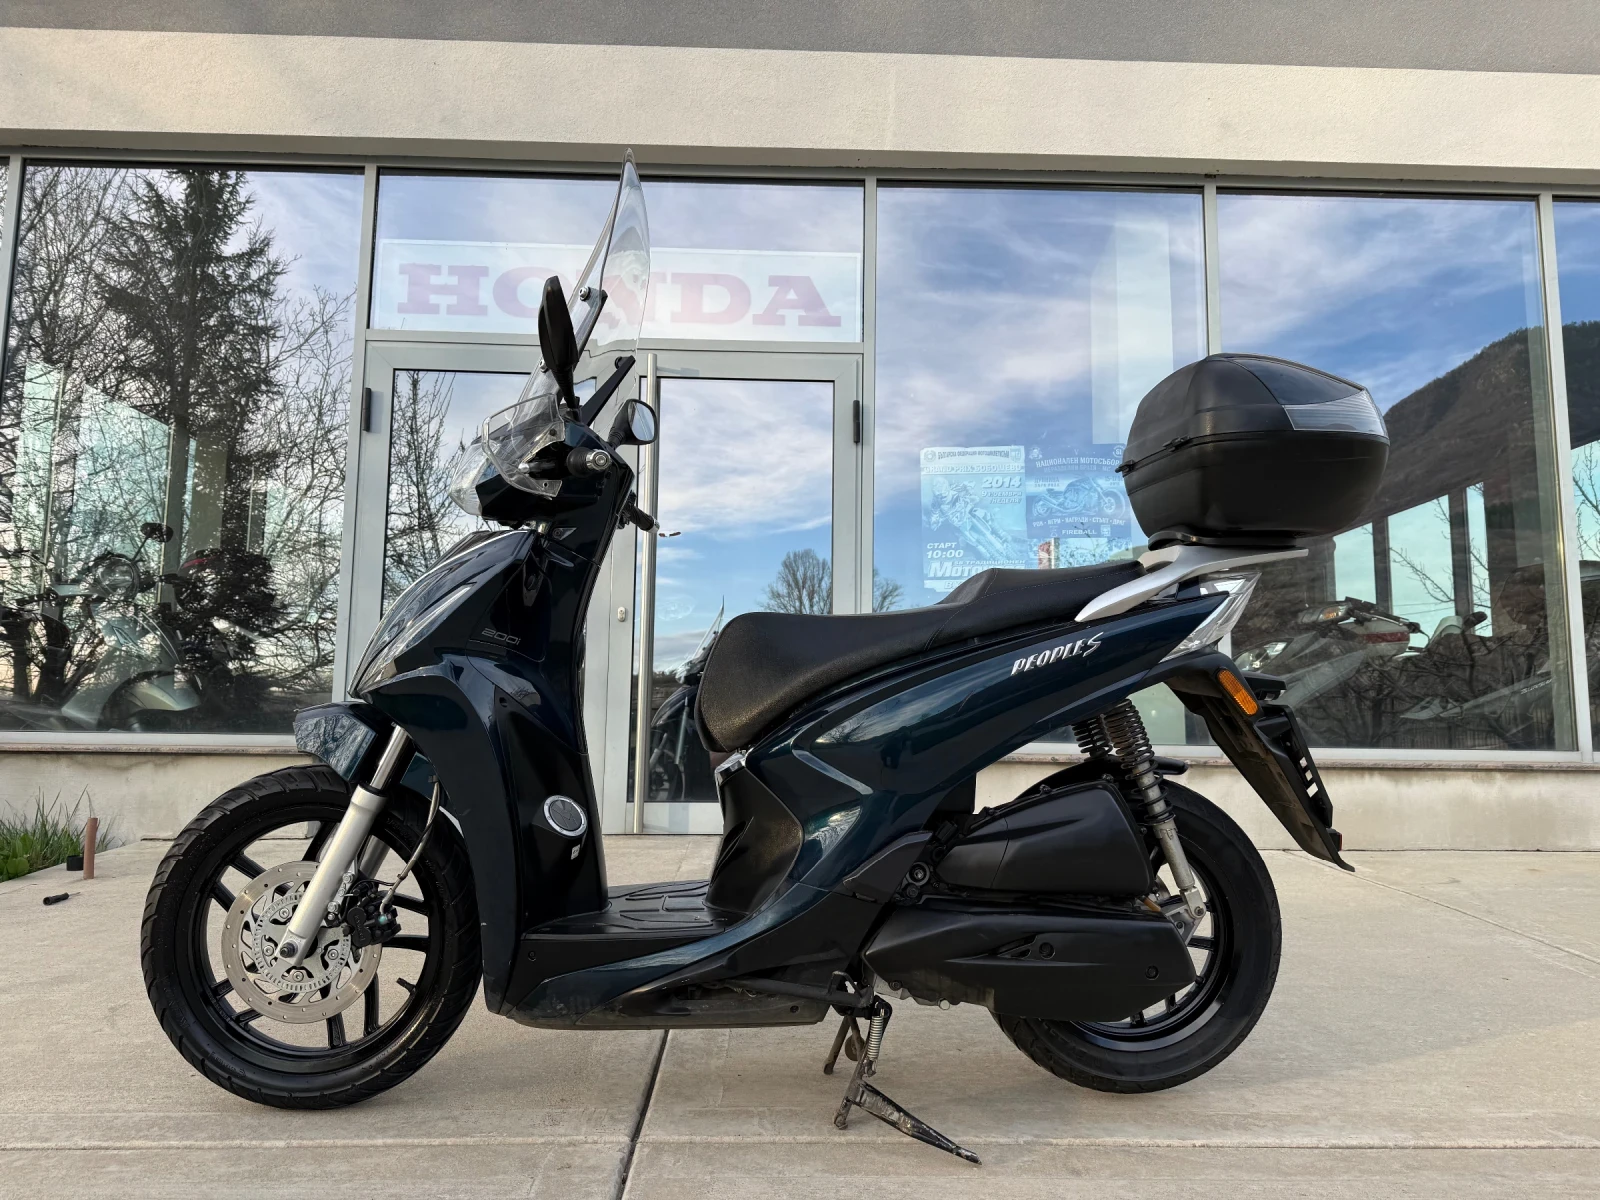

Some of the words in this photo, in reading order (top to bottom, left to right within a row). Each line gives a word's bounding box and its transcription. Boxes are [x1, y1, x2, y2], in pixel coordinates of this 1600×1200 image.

[397, 263, 842, 327] HONDA
[1036, 457, 1079, 468] НАЦИОНАЛЕН
[1080, 457, 1120, 466] МОТОСЪБОР
[981, 476, 1022, 489] 2014
[926, 549, 964, 559] 10:00
[481, 627, 521, 645] 200i
